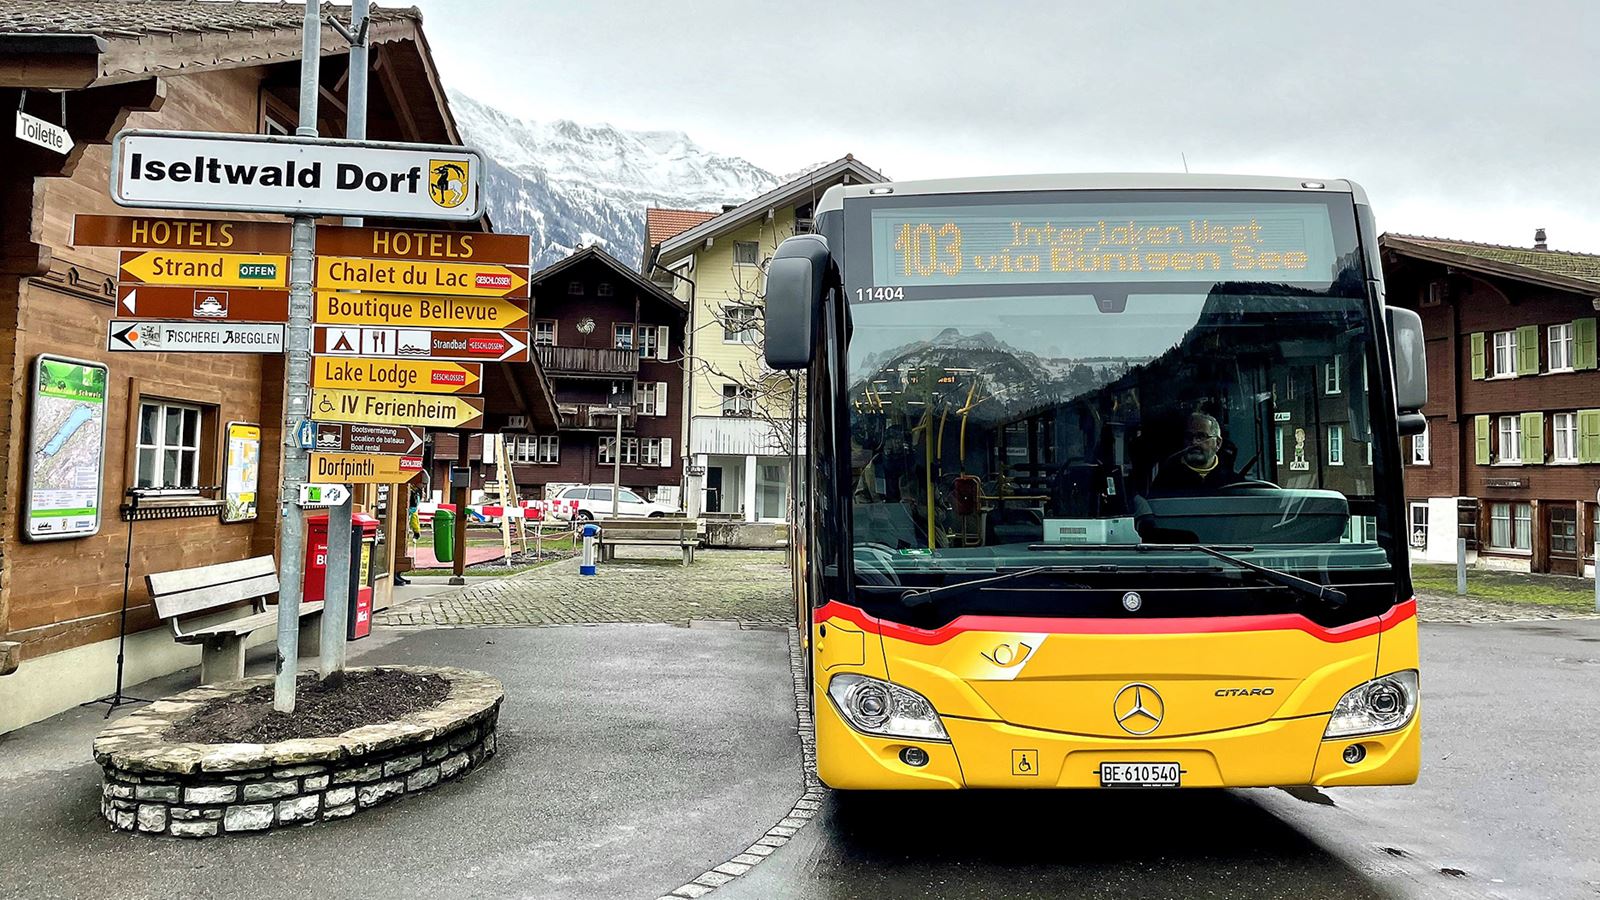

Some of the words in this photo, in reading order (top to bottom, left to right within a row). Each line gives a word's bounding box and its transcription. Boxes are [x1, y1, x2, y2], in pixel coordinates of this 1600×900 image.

[20, 116, 63, 150] Toilette
[130, 153, 322, 189] Iseltwald
[336, 163, 420, 194] Dorf
[131, 220, 234, 248] HOTELS
[1011, 219, 1184, 246] Interlaken
[1190, 217, 1264, 245] West
[373, 230, 474, 259] HOTELS
[894, 222, 962, 277] 103
[152, 257, 223, 277] Strand
[240, 266, 275, 276] OFFEN
[974, 248, 1041, 273] via
[1231, 245, 1308, 271] See
[329, 262, 395, 284] Chalet
[403, 265, 427, 285] du
[435, 267, 468, 287] Lac
[856, 287, 904, 301] 11404
[328, 297, 412, 322] Boutique
[420, 300, 498, 320] Bellevue
[166, 329, 220, 343] FISCHEREI
[222, 330, 280, 344] ABEGGLEN
[433, 339, 467, 350] Strandbad
[325, 362, 363, 382] Lake
[369, 364, 417, 389] Lodge
[341, 395, 359, 415] IV
[365, 397, 457, 420] Ferienheim
[350, 434, 375, 443] Location
[383, 436, 405, 444] bateaux
[351, 425, 397, 436] Bootsvermietung
[350, 443, 364, 451] Boat
[1215, 688, 1275, 697] CITARO
